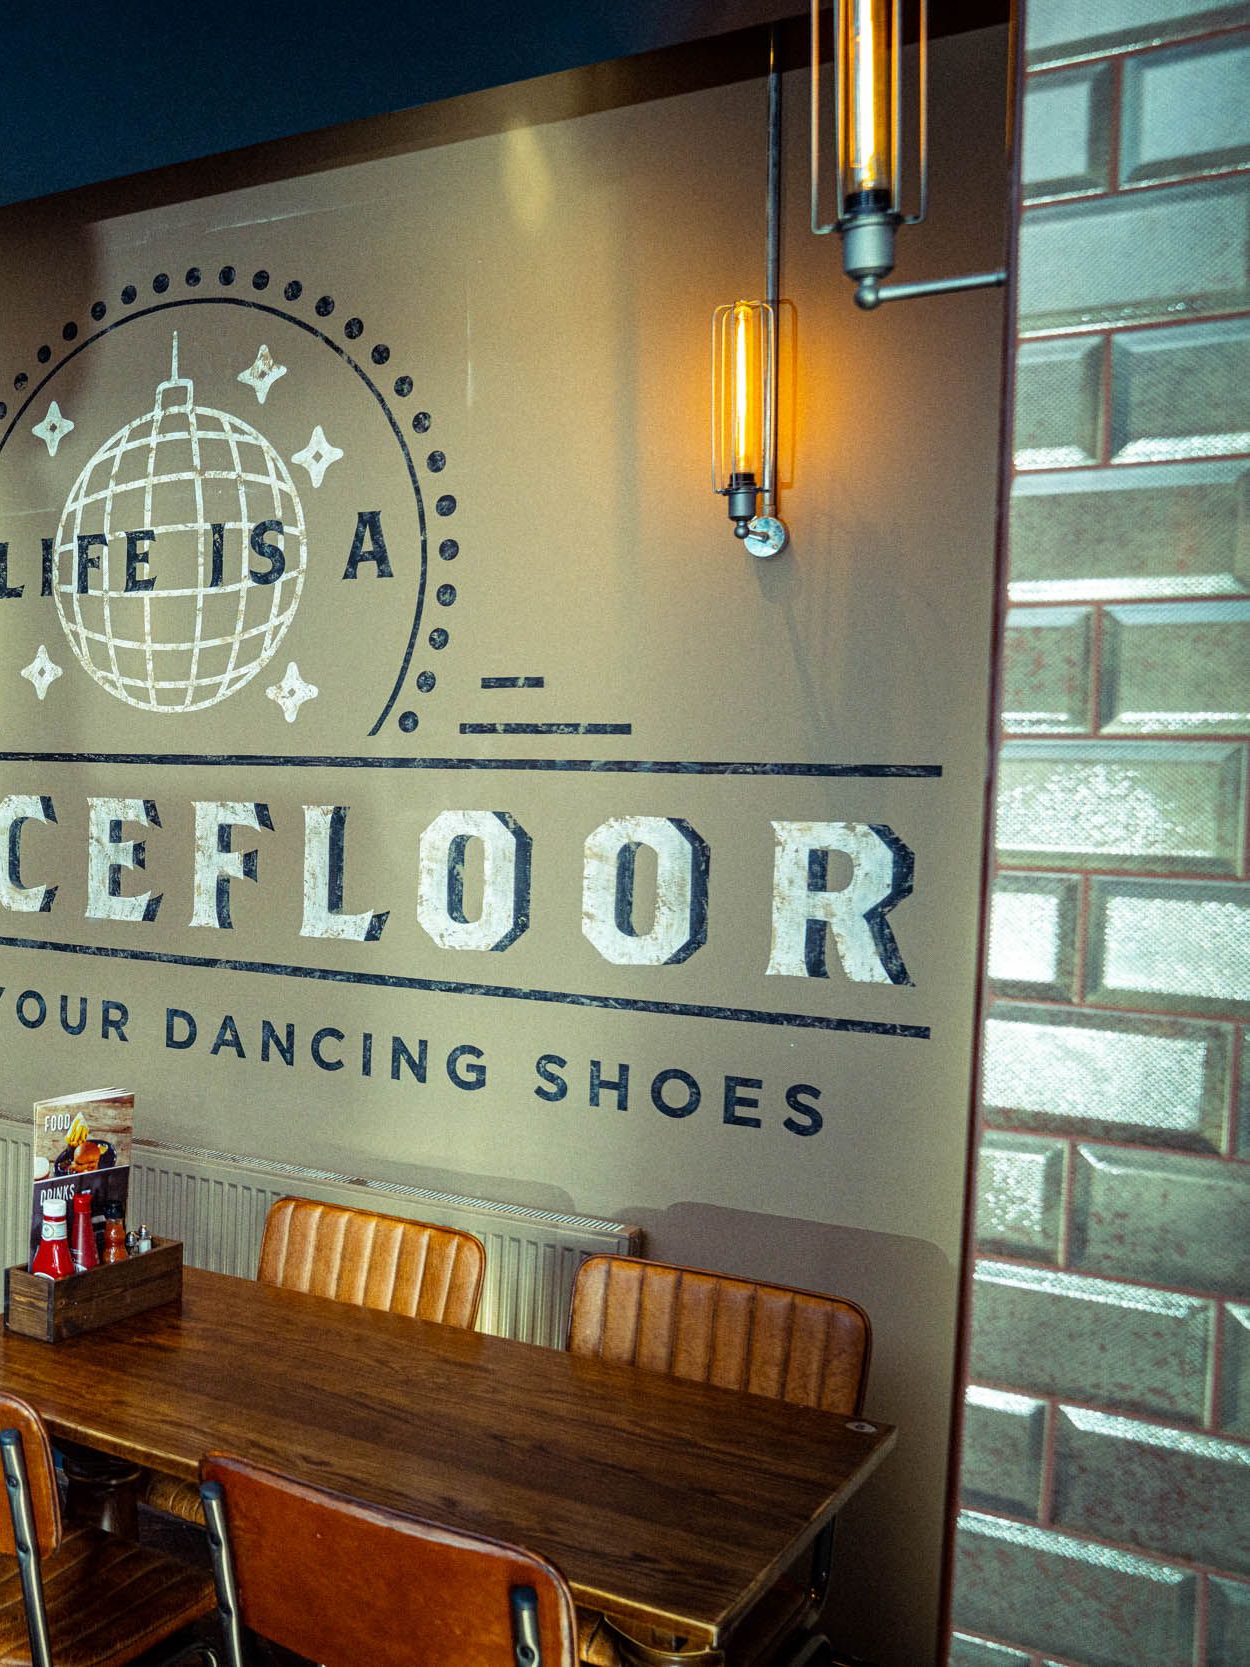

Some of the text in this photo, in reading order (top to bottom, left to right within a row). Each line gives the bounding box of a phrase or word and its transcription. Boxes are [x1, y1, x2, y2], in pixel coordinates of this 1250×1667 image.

[209, 519, 286, 588] IS
[342, 510, 394, 580] A
[166, 1007, 487, 1091] DANCING
[534, 1054, 824, 1137] SHOES
[44, 1113, 71, 1134] FOOD
[40, 1183, 76, 1207] DRINKS
